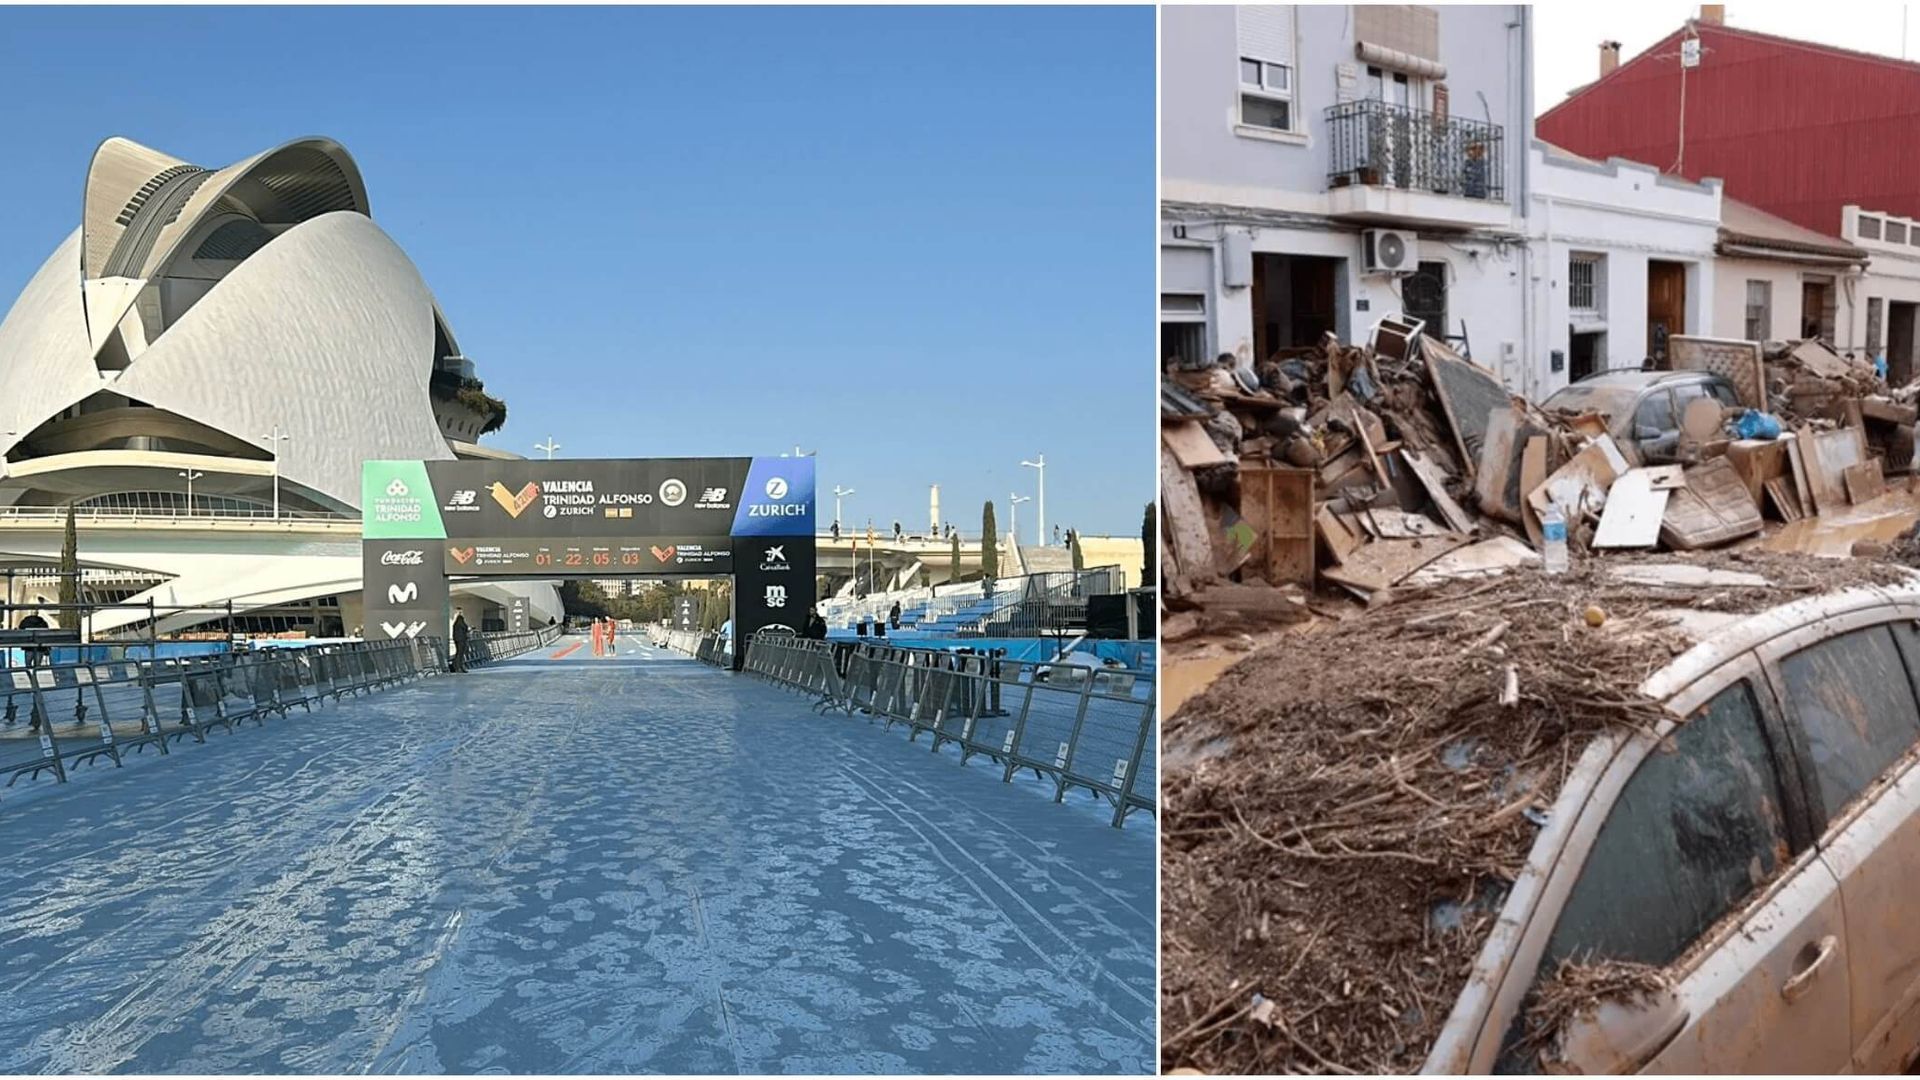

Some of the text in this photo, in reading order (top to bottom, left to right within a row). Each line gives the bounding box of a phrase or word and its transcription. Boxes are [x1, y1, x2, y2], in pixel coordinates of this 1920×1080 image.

[542, 481, 594, 493] VALENCIA
[543, 494, 653, 505] TRINIDAD ALFONSO
[375, 504, 422, 513] TRINIDAD
[559, 507, 594, 516] ZURICH
[749, 504, 806, 517] ZURICH
[376, 513, 421, 522] ALFONSO
[536, 553, 639, 565] 01 22 05 03
